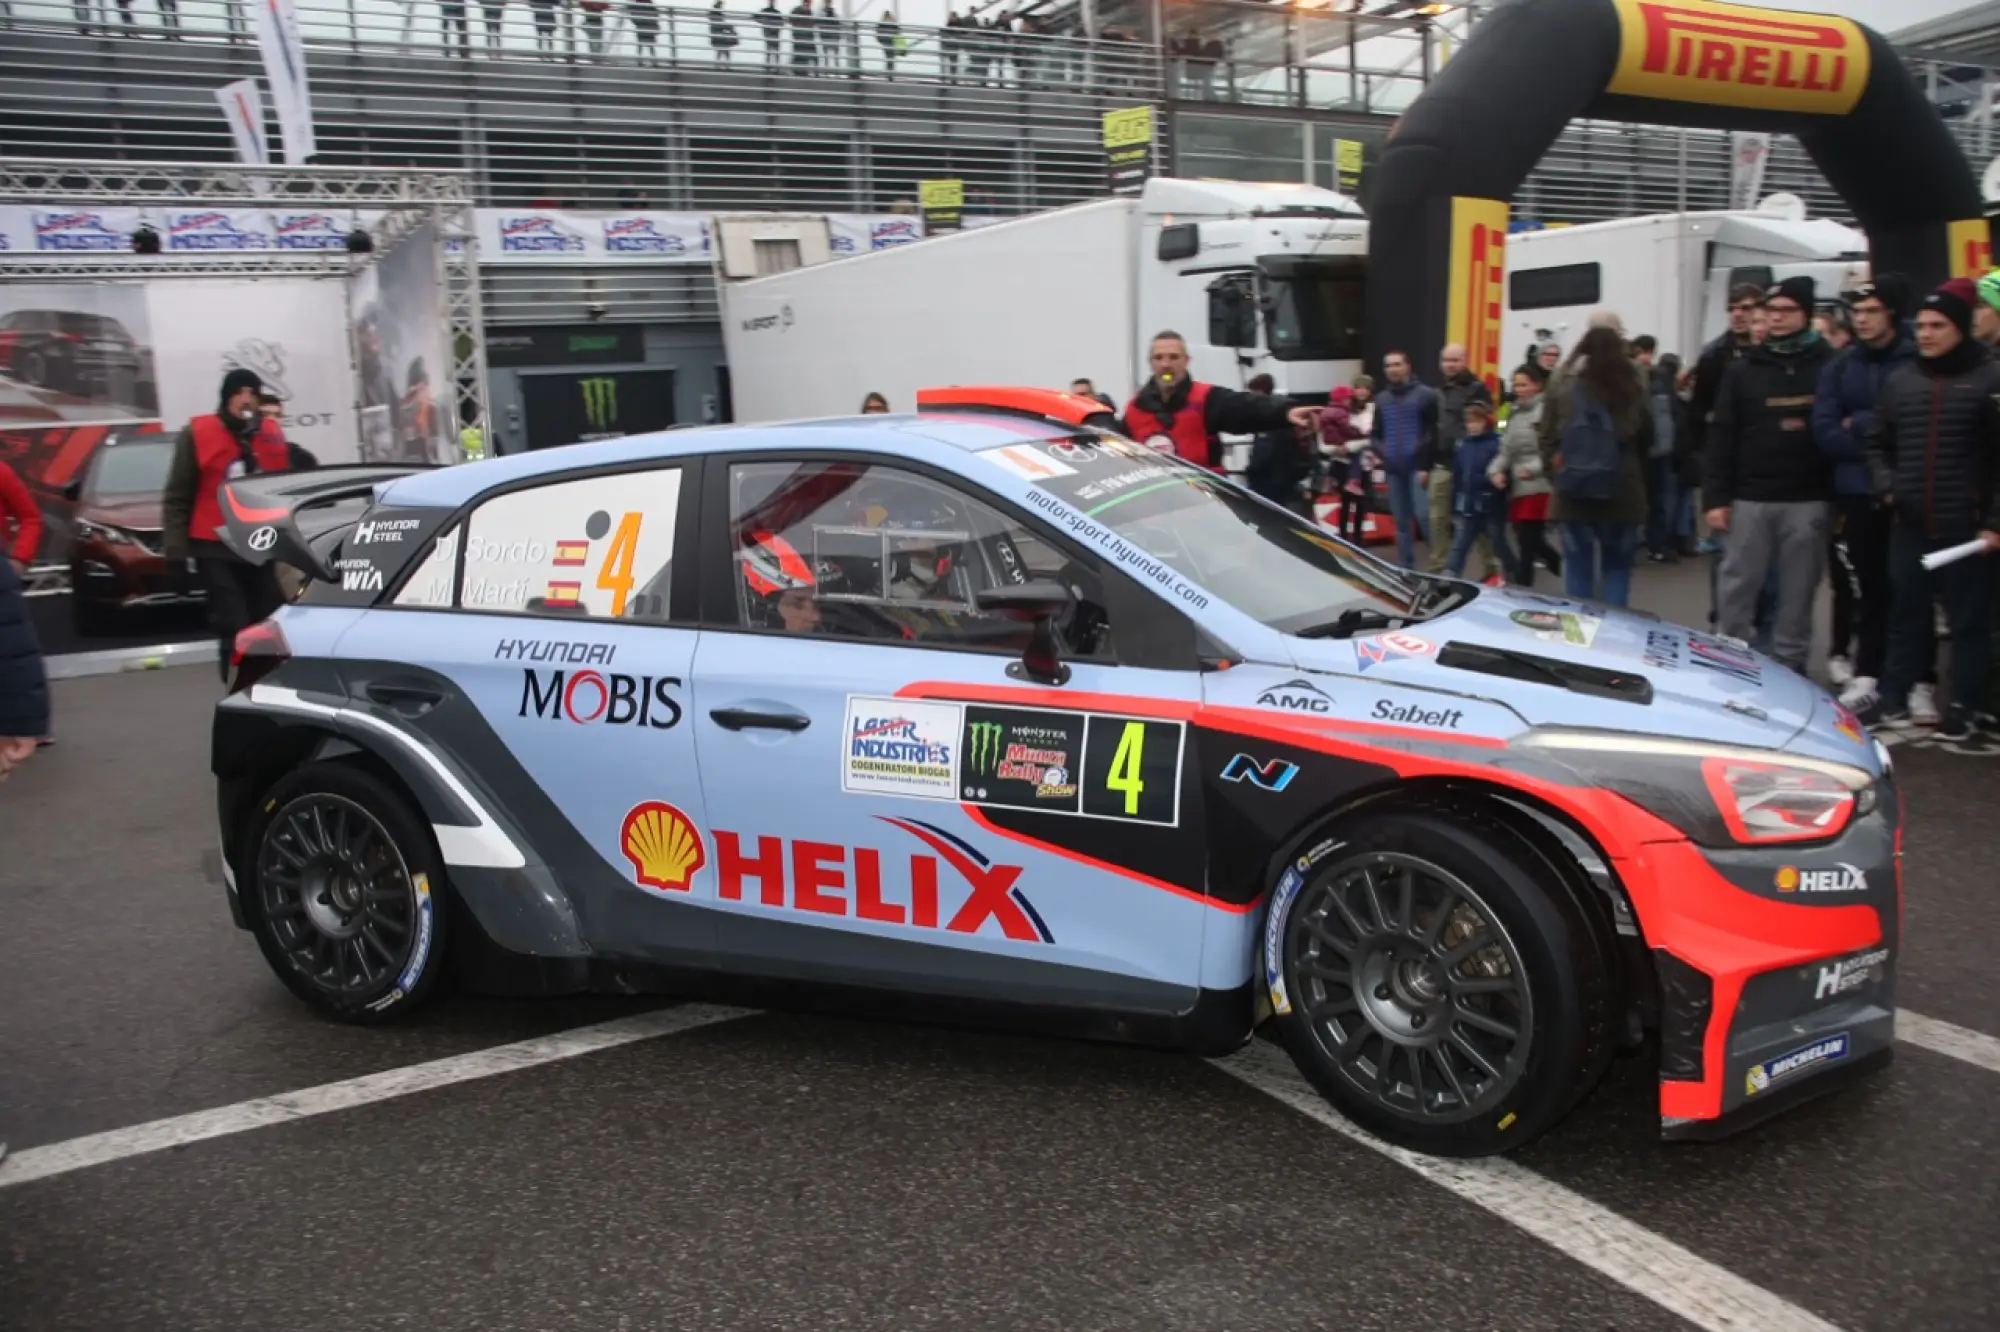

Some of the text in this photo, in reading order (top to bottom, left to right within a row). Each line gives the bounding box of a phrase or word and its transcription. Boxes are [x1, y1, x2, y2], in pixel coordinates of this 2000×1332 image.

[1637, 3, 1847, 92] PIRELLI
[372, 531, 404, 543] STEEL
[376, 520, 420, 531] HYUNDAI
[466, 534, 547, 564] Sordo
[1025, 488, 1209, 610] motorsport.hyundai.com
[596, 511, 643, 618] 4
[495, 639, 617, 664] HYUNDAI
[518, 667, 682, 729] MOBIS
[1256, 692, 1330, 713] AMG
[1371, 699, 1464, 729] Sabelt
[1011, 726, 1068, 741] MONSTER
[851, 760, 951, 778] COGENERATORI BIOGAS
[997, 760, 1045, 785] Rally
[1106, 722, 1145, 815] 4
[709, 815, 1054, 943] HELIX
[1800, 864, 1868, 891] HELIX
[1267, 871, 1296, 971] MICHELIN
[1771, 1039, 1844, 1076] MICHELIN
